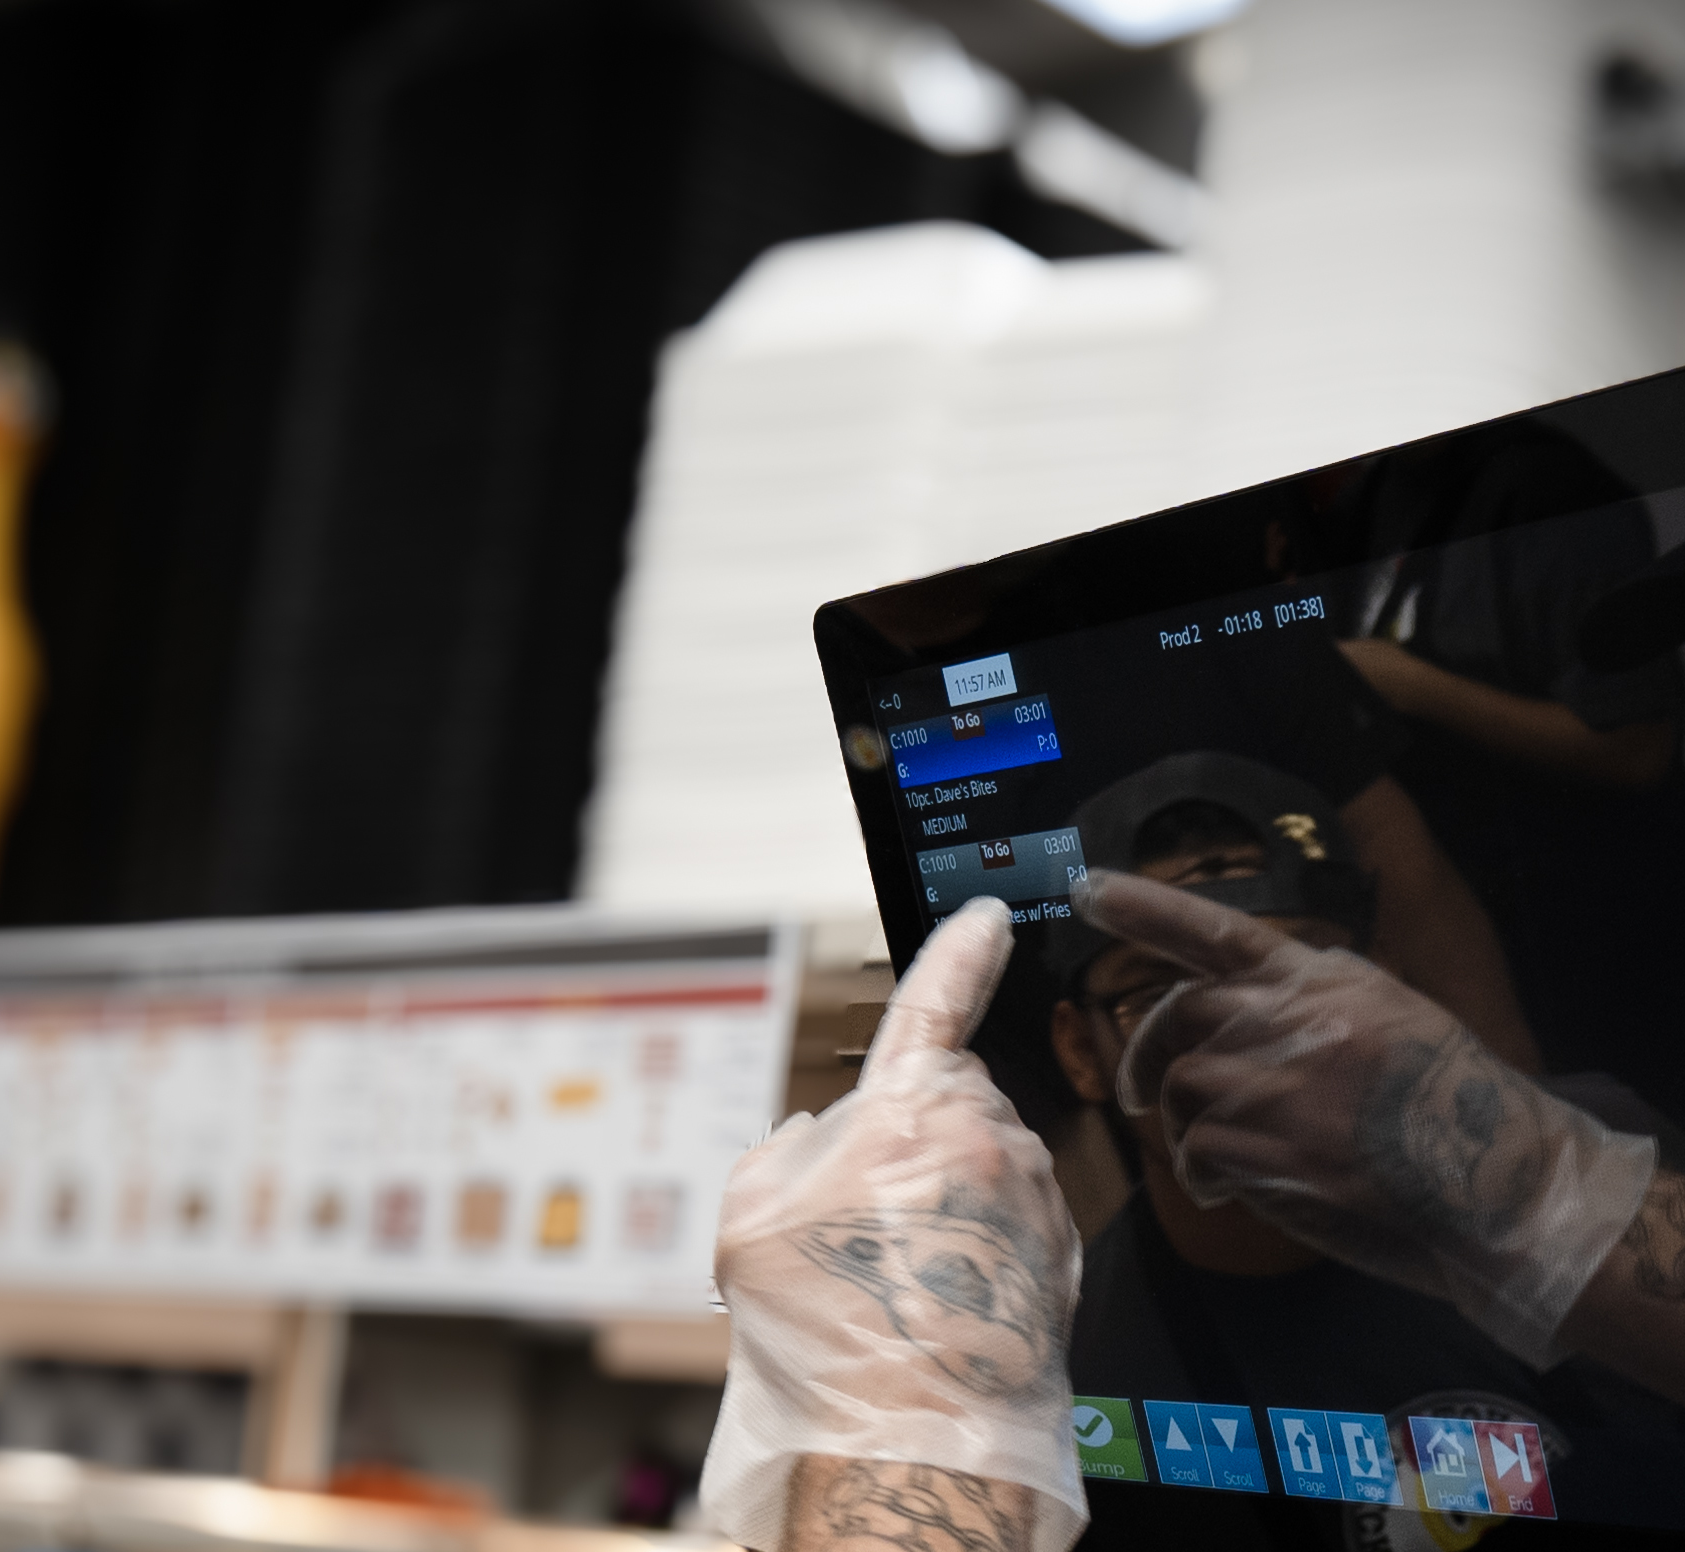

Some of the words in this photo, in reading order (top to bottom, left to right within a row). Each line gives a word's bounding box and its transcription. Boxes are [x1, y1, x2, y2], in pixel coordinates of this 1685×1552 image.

[1274, 595, 1326, 629] [01:38]
[954, 674, 984, 696] 11:57
[988, 669, 1008, 689] AM
[889, 727, 928, 750] C:1010
[951, 715, 965, 731] To
[965, 712, 981, 728] Go
[1014, 701, 1047, 724] 03:01
[897, 762, 910, 779] G:
[905, 791, 934, 812] 10pc.
[934, 782, 970, 804] Dave's
[970, 779, 998, 798] Bites
[921, 813, 968, 836] MEDIUM
[918, 853, 957, 875] C:1010
[980, 843, 994, 859] To
[995, 841, 1010, 857] Go
[1043, 833, 1077, 856] 03:01
[926, 886, 939, 903] G:
[1027, 903, 1041, 922] w/
[1042, 902, 1071, 919] Fries
[1170, 1465, 1201, 1483] Scroll
[1223, 1470, 1255, 1488] Scroll
[1298, 1477, 1327, 1496] Page
[1356, 1481, 1386, 1500] Page
[1437, 1488, 1475, 1508] Home
[1507, 1494, 1534, 1513] End
